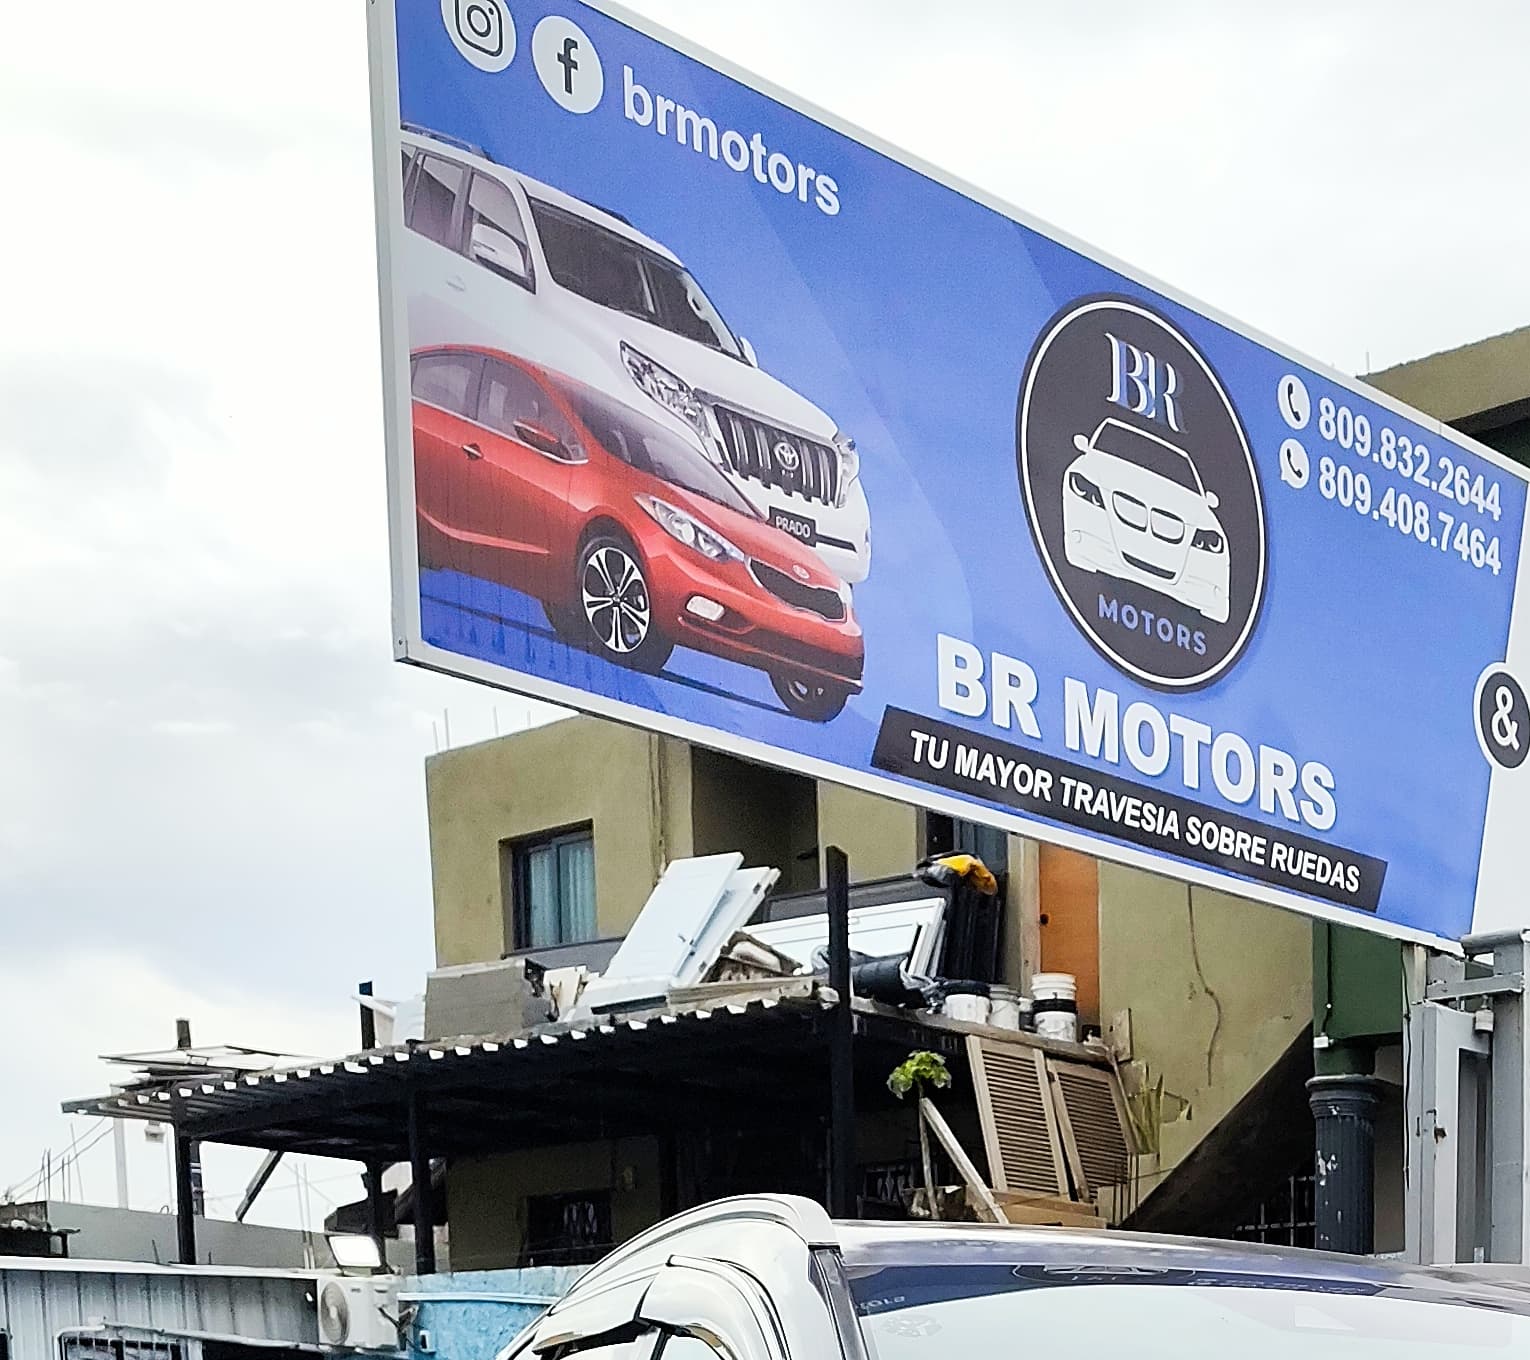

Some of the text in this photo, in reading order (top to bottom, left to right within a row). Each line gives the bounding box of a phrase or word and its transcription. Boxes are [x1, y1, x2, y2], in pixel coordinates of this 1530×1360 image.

[622, 65, 841, 216] brmotors
[1104, 332, 1187, 434] BR
[1318, 397, 1502, 521] 809.832.2644
[1318, 457, 1502, 575] 809.408.7464
[775, 515, 811, 538] PRADO
[1098, 593, 1207, 655] MOTORS
[936, 633, 1337, 831] BR MOTORS
[910, 730, 1360, 893] TU MAYOR TRAVESIA SOBRE RUEDAS
